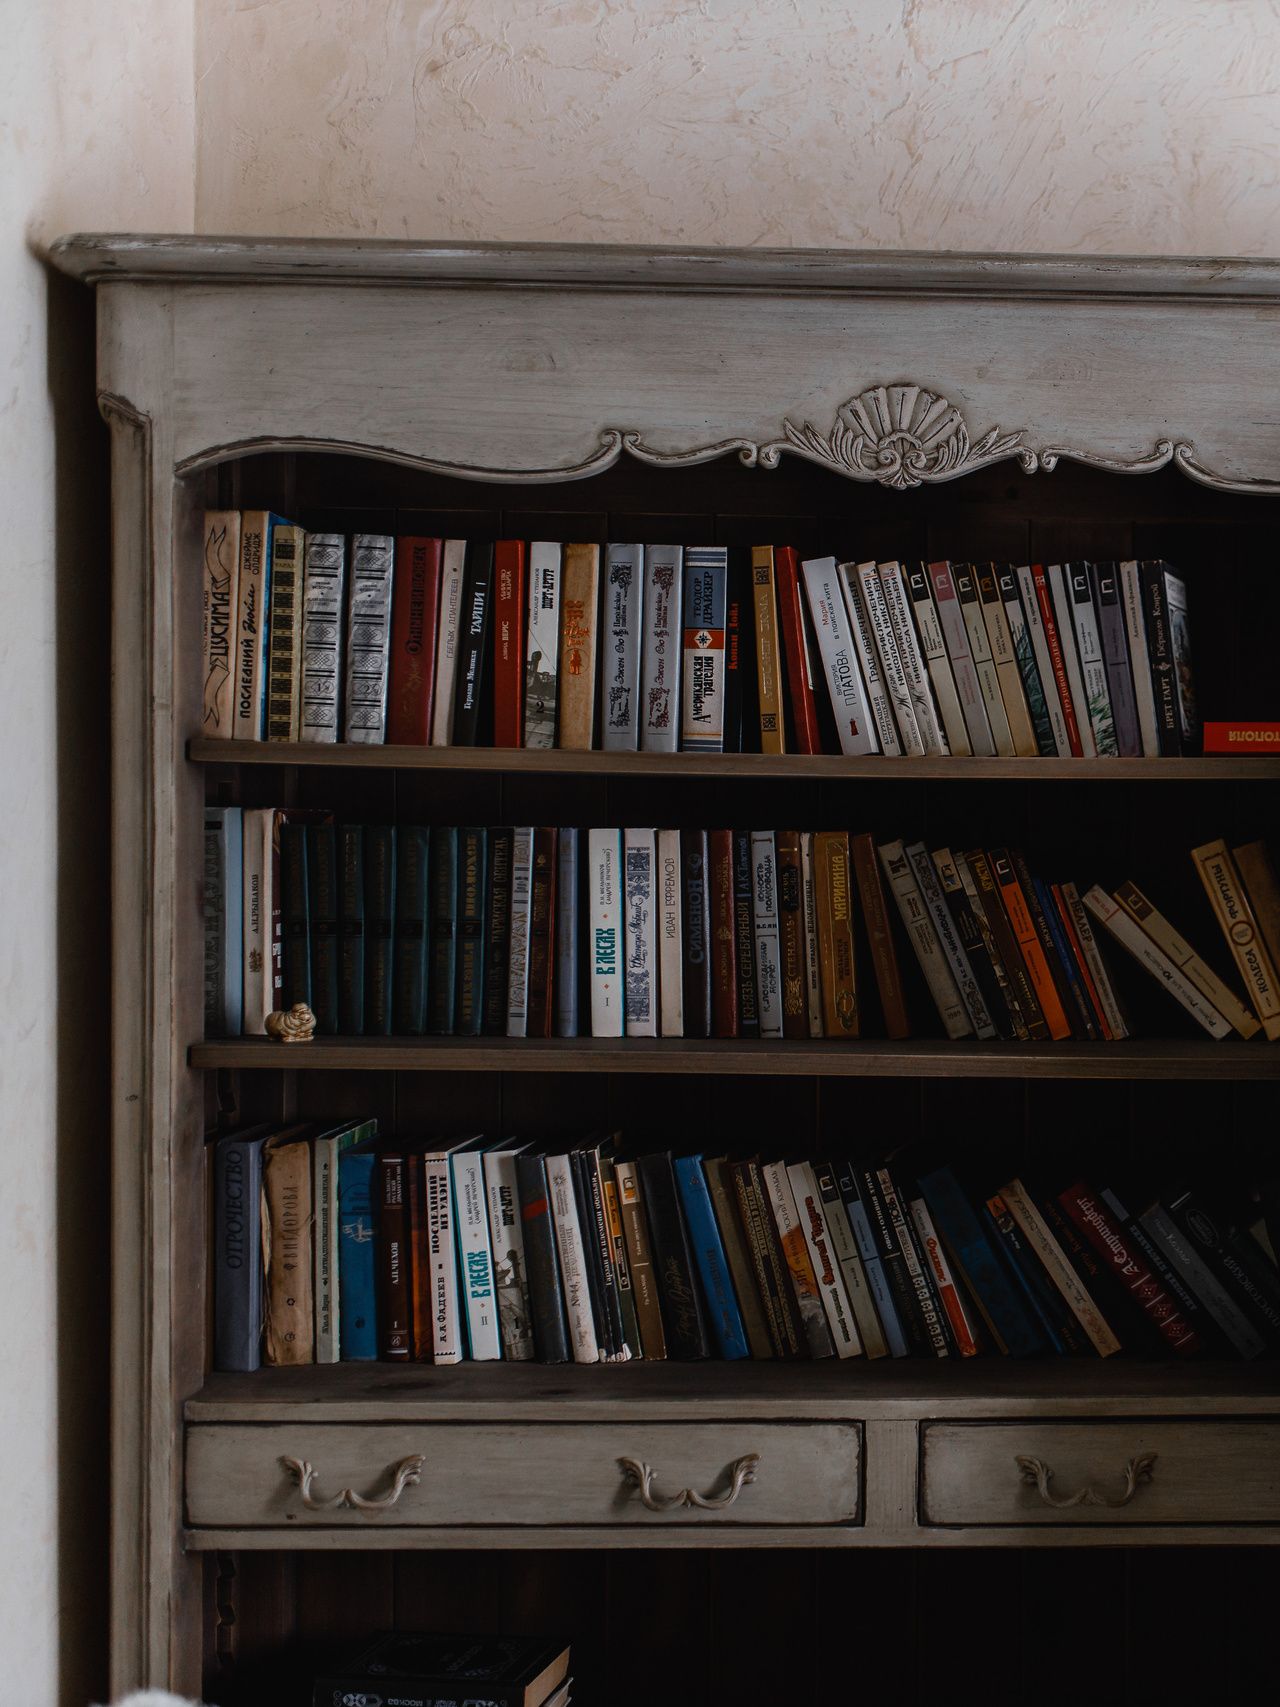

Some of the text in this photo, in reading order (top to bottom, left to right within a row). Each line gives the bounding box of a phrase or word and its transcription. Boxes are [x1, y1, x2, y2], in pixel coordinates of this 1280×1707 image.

[243, 532, 253, 570] ДЖЕЙМС
[252, 532, 261, 575] ОЛДРИДЖ
[412, 547, 426, 589] ВОВЕК
[470, 591, 486, 635] ТАЙПИ
[693, 578, 702, 619] ТЕОДОР
[703, 571, 714, 625] ДРАЙЗЕР
[818, 600, 829, 626] Мария
[822, 582, 832, 600] кита
[1150, 583, 1161, 616] Конрой
[210, 592, 229, 657] ЦУСИМА
[728, 603, 739, 670] Конан Дойл
[826, 602, 839, 633] поисках
[864, 578, 890, 661] ПРИКЛЮЧЕНИЯ
[872, 576, 905, 686] НИКОЛАСА НИКЛЬБИ
[883, 578, 907, 659] ПРИКЛЮЧЕНИЯ
[891, 576, 921, 683] НИКОЛАСА НИКЛЬБИ
[614, 638, 625, 684] Эжен Сю
[655, 639, 666, 685] Эжен Сю
[1050, 636, 1063, 668] КОДЕКС
[240, 639, 255, 718] ПОСЛЕДНИЙ
[464, 683, 475, 710] Герман
[692, 656, 711, 724] Американская
[703, 656, 715, 698] трагедия
[831, 664, 843, 696] ВИКТОРИЯ
[835, 648, 857, 706] ПЛАТОВА
[1056, 670, 1072, 713] ТРУДОВОЙ
[1161, 677, 1172, 701] ГАРТ
[1164, 703, 1174, 729] БРЕТ
[665, 858, 675, 938] ИВАН ЕФРЕМОВ
[832, 855, 847, 920] МАРИАННА
[974, 860, 994, 891] КРИСТИ
[462, 834, 477, 1024] МИХАИЛ ШОЛОХОВ
[491, 886, 507, 943] ПАРМСКАЯ
[688, 879, 704, 963] СИМЕНОН
[1038, 916, 1054, 948] ДЖУНА
[1070, 899, 1093, 942] ВЕЛЛЕР
[1211, 863, 1269, 994] КОЛЕСА ФОРТУНЫ
[595, 928, 616, 975] В ЛЕСАХ
[738, 902, 755, 1018] КНЯЗЬ СЕРЕБРЯНЫЙ
[786, 920, 796, 977] СТЕНДАЛЬ
[438, 1175, 448, 1210] УДЭГЕ
[771, 1170, 784, 1201] КОРАБЛЬ
[225, 1150, 243, 1269] ОТРОЧЕСТВО
[428, 1175, 440, 1254] ПОСЛЕДНИЙ
[872, 1196, 886, 1225] ОЛИВИЯ
[886, 1197, 902, 1223] НОВЬ
[467, 1251, 491, 1298] В ЛЕСАХ
